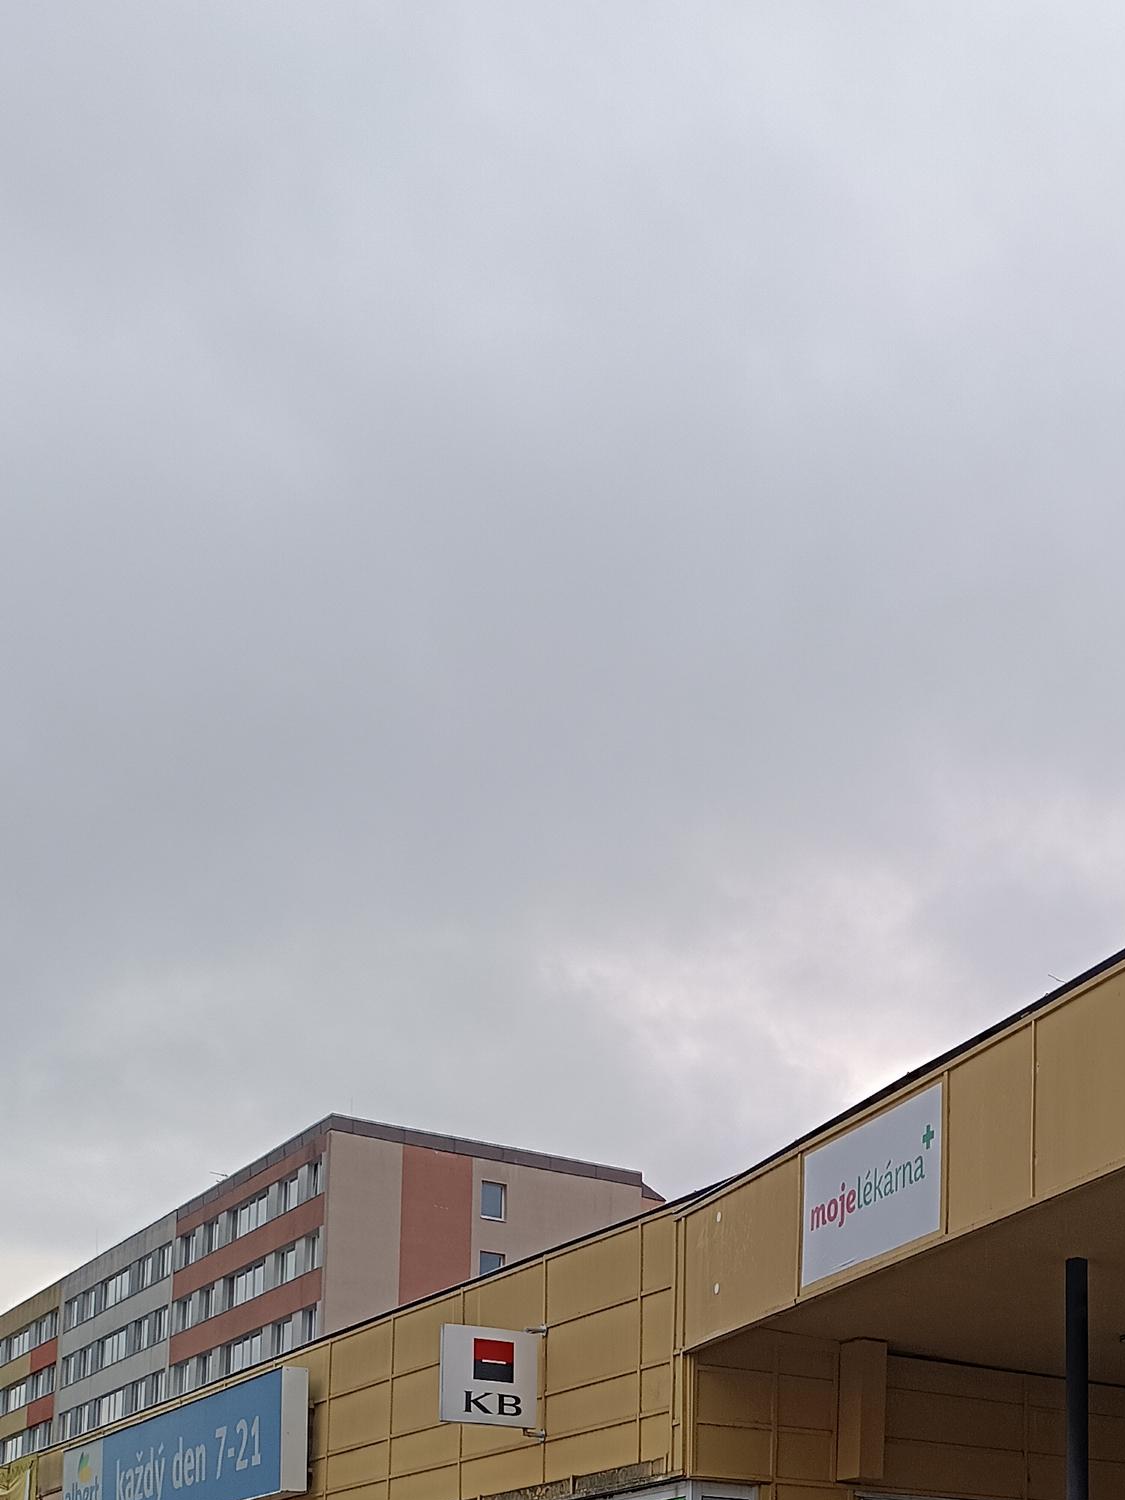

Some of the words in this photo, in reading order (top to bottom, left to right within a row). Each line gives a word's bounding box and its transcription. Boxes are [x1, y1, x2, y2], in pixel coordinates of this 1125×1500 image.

[464, 1390, 522, 1416] KB
[172, 1437, 206, 1490] den
[215, 1416, 261, 1480] 7-21
